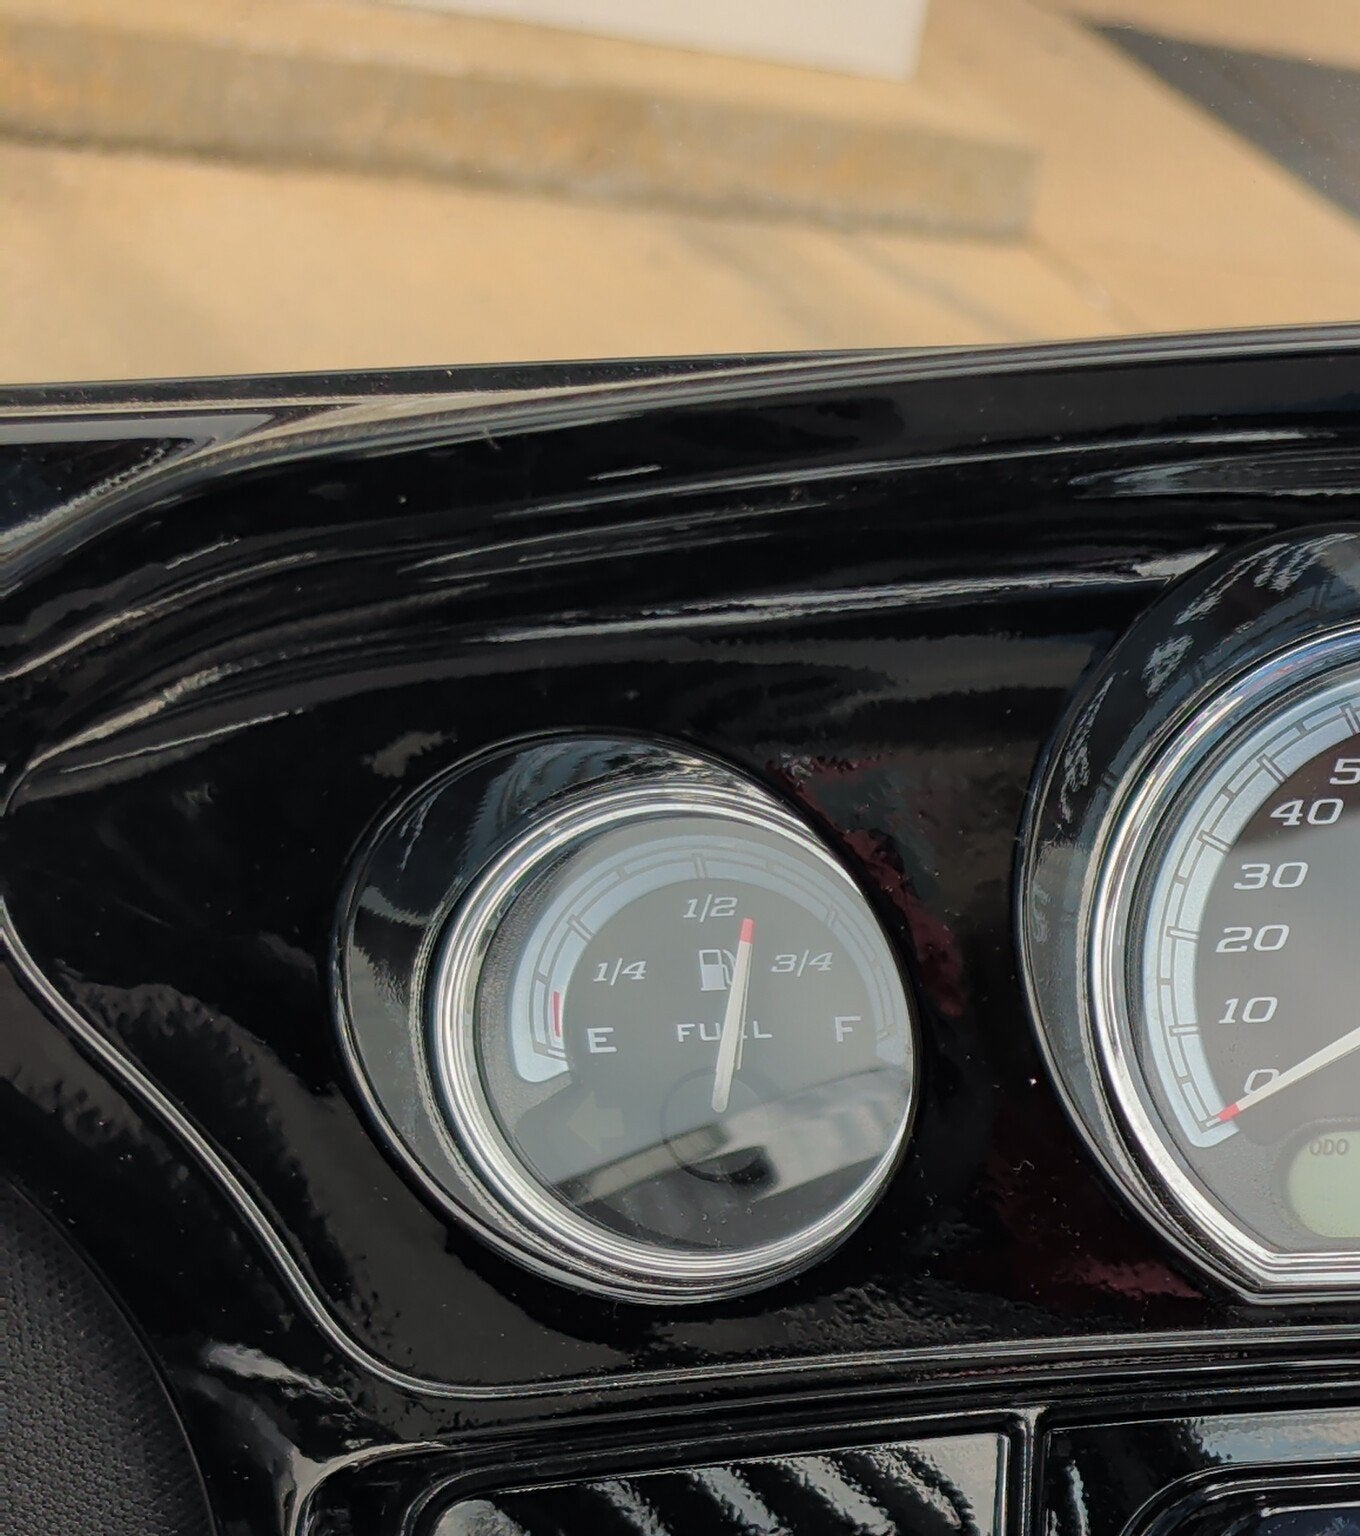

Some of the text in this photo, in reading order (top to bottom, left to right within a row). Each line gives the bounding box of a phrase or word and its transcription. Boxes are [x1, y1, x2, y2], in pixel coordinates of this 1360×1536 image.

[1270, 798, 1343, 827] 40
[1233, 861, 1308, 890] 30
[682, 895, 738, 922] 1/2
[1215, 924, 1290, 953] 20
[592, 958, 648, 984] 1/4
[771, 949, 833, 976] 3/4
[1218, 997, 1278, 1025] 10
[587, 1027, 618, 1053] E
[676, 1020, 773, 1042] FUL
[834, 1016, 861, 1042] F
[1244, 1068, 1280, 1095] 0
[1309, 1138, 1348, 1156] ODO
